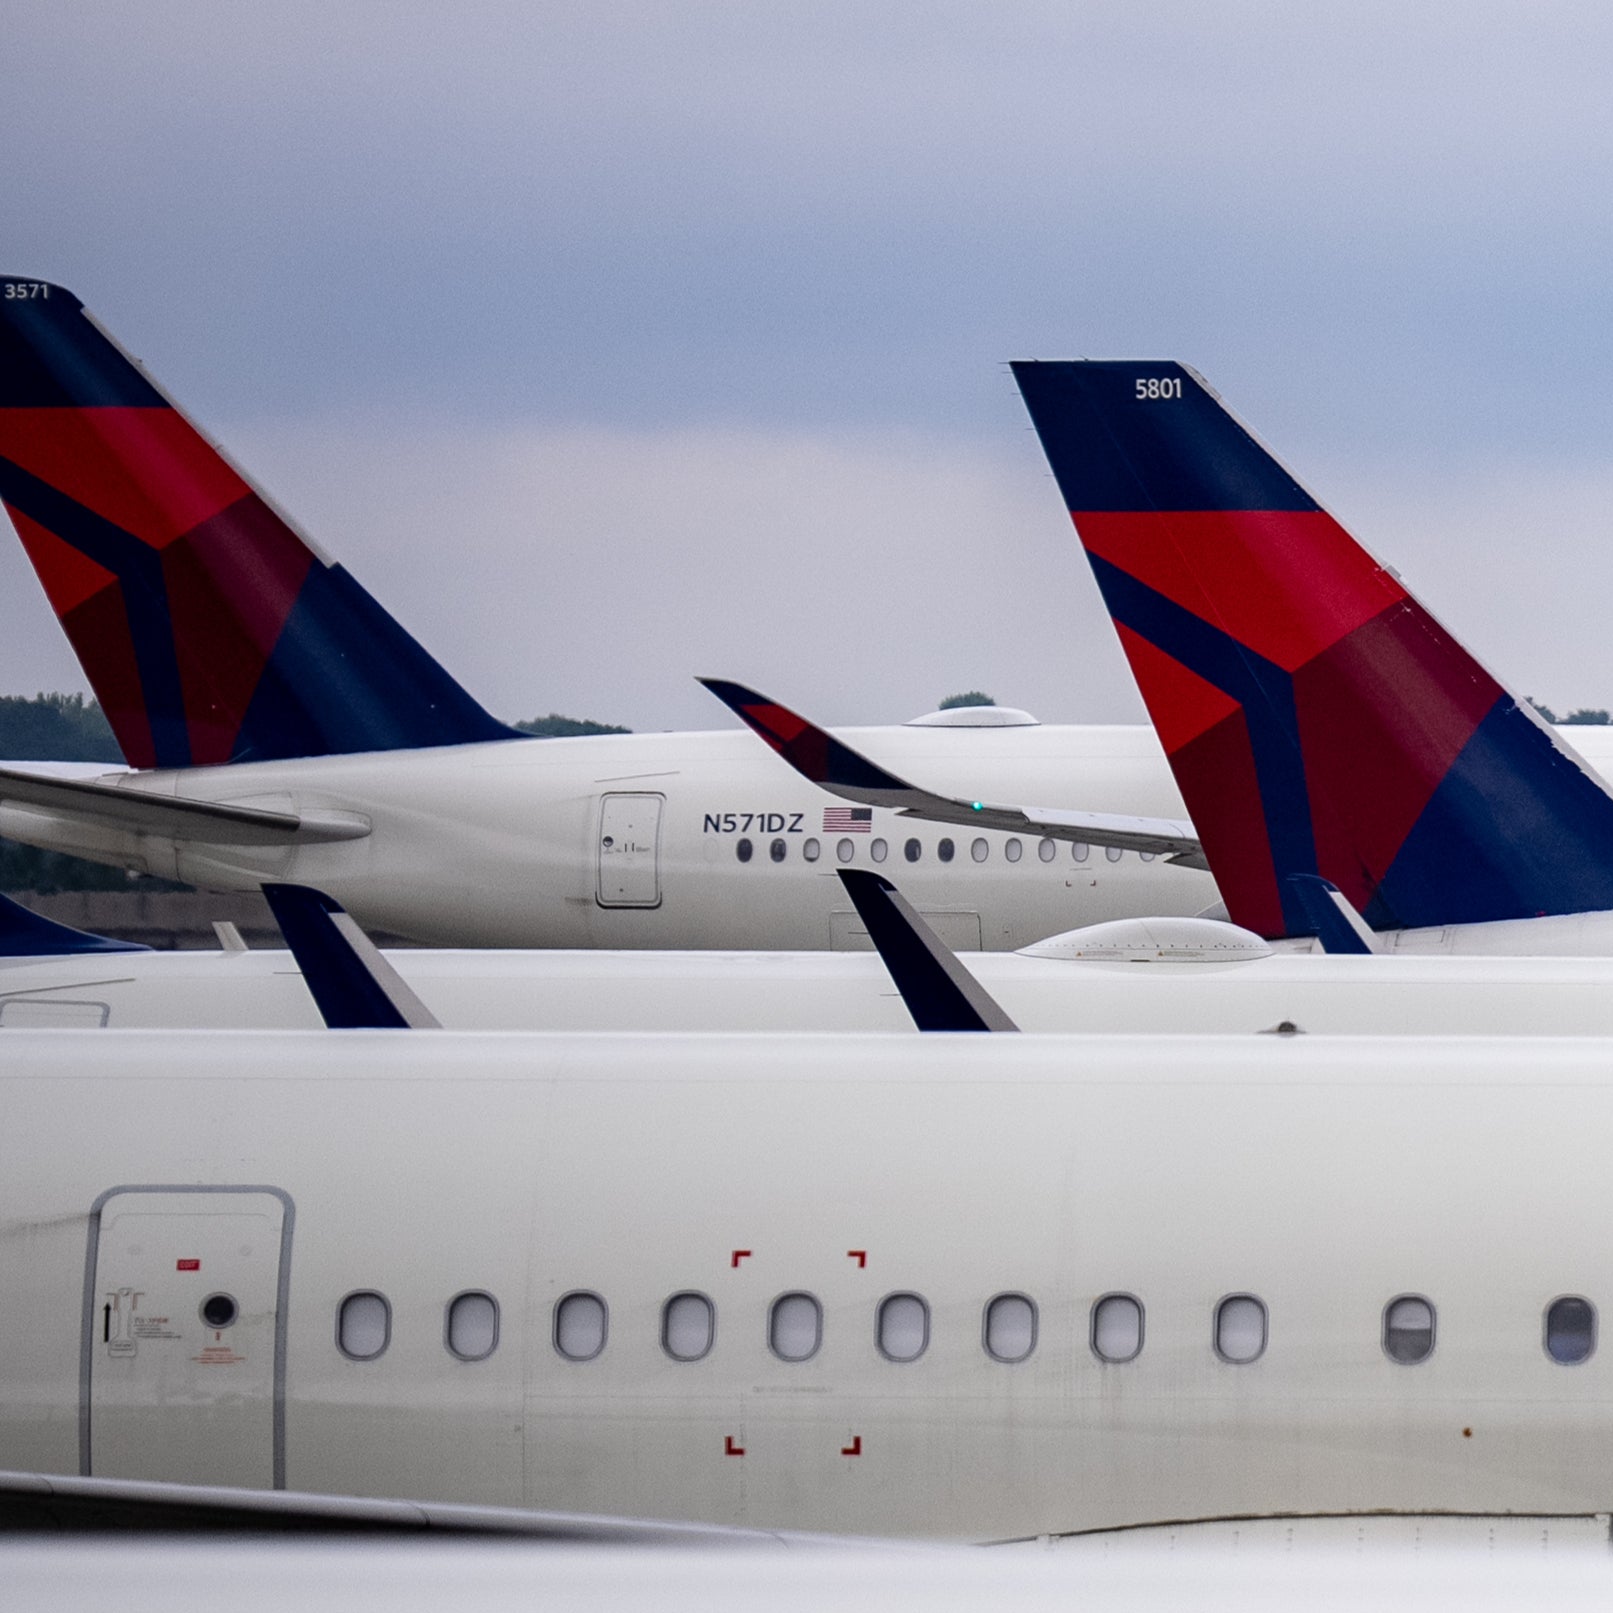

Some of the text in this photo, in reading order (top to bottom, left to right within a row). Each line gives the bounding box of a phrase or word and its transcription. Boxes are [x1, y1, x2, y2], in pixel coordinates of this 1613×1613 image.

[4, 283, 49, 300] 3571
[1136, 377, 1181, 399] 5801
[702, 813, 804, 833] N571DZ
